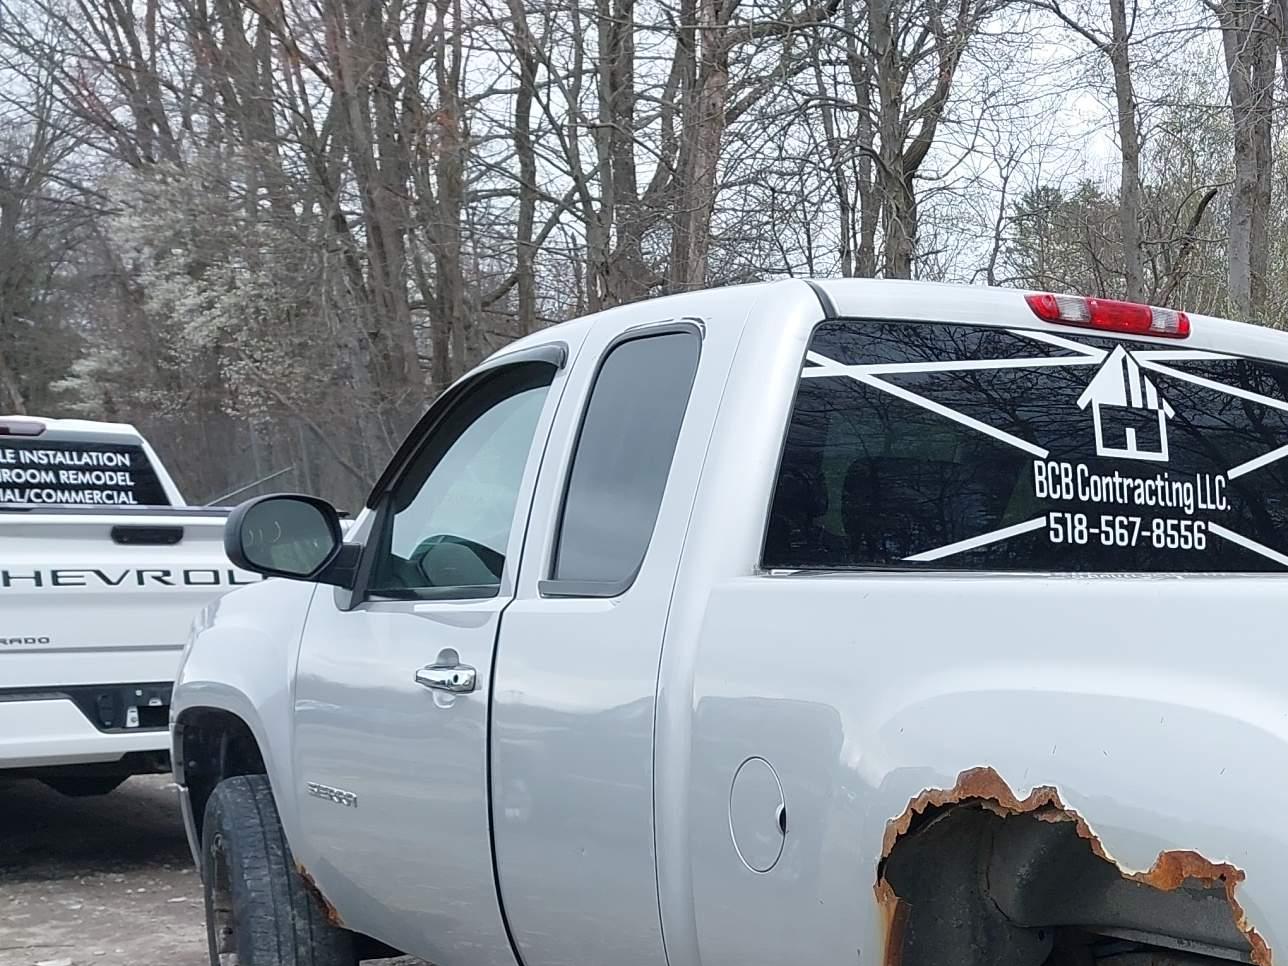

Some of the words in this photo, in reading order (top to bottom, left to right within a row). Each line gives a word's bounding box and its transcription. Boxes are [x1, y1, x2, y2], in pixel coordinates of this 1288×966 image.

[19, 449, 131, 467] INSTALLATION
[0, 468, 56, 484] ROOM
[59, 470, 135, 486] REMODEL
[1033, 460, 1074, 500] BCB
[1076, 463, 1194, 515] Contracting
[1196, 473, 1232, 512] LLC.
[1048, 512, 1207, 550] 518-567-8556
